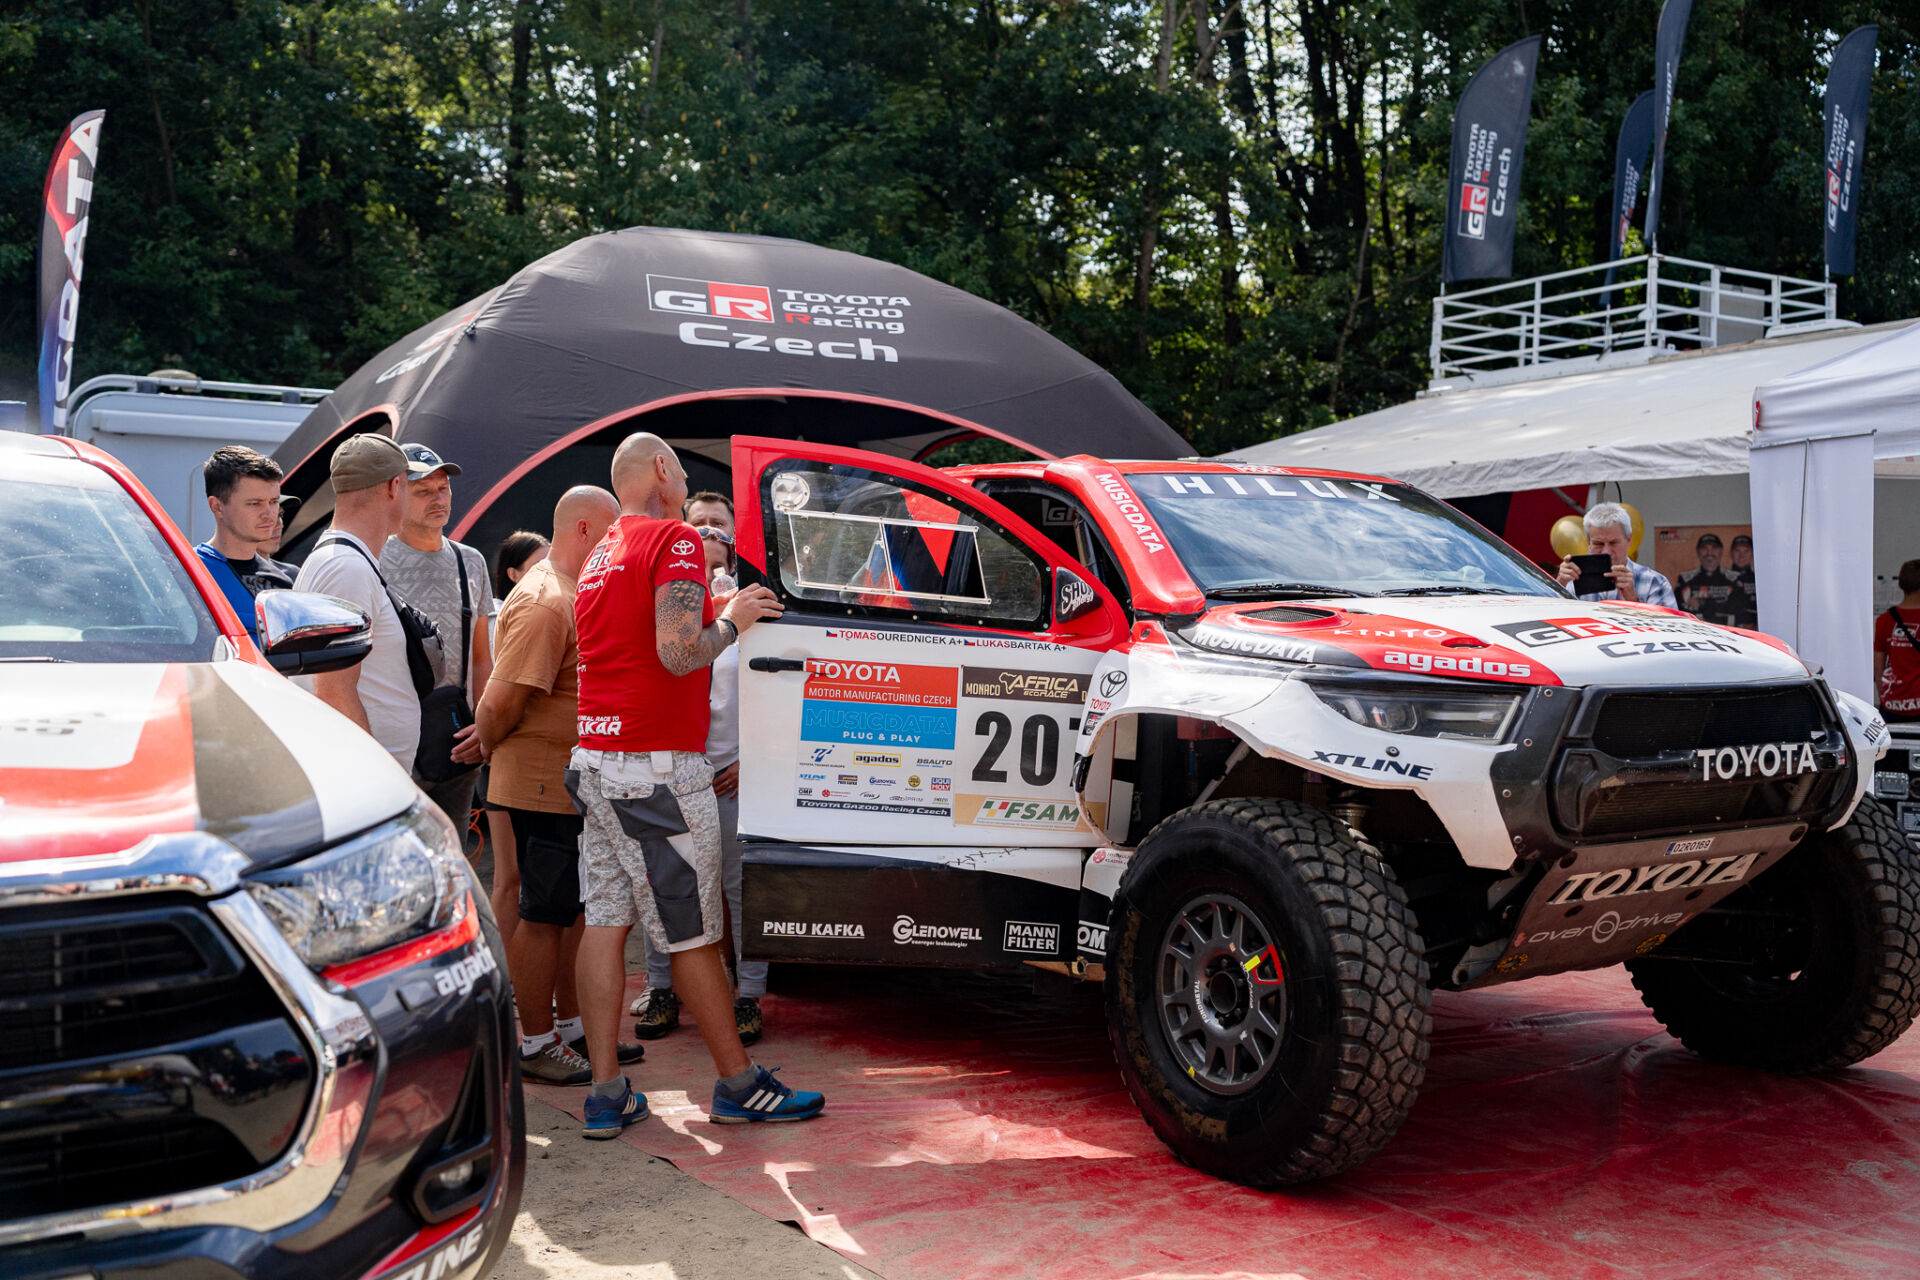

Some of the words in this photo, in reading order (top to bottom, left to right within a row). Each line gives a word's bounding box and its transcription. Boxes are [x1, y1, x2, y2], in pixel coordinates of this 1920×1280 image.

[1464, 123, 1480, 180] TOYOTA
[1473, 129, 1487, 182] GAZOO
[1481, 131, 1498, 183] Racing
[1492, 147, 1512, 217] Czech
[1840, 139, 1855, 212] Czech
[1468, 187, 1487, 236] GR
[654, 290, 769, 320] GR
[777, 289, 911, 307] TOYOTA
[782, 302, 904, 319] GAZOO
[785, 313, 905, 335] Racing
[678, 322, 899, 363] Czech
[1163, 476, 1400, 501] HILUX
[1095, 473, 1164, 554] MUSICDATA
[578, 579, 603, 593] Czech
[949, 637, 962, 645] A+
[1334, 628, 1447, 639] KINTO
[1515, 617, 1625, 647] GR
[1191, 631, 1317, 663] MUSICDATA
[1597, 640, 1743, 657] Czech
[811, 660, 901, 683] TOYOTA
[1384, 650, 1531, 678] agados
[808, 688, 841, 698] MOTOR
[843, 690, 921, 703] MANUFACTURING
[923, 695, 952, 705] CZECH
[965, 683, 1000, 697] MONACO
[1009, 674, 1079, 692] AFRICA
[577, 721, 622, 737] AKAR
[805, 708, 952, 735] MUSICDATA
[842, 731, 874, 740] PLUG
[878, 733, 885, 741] &
[891, 734, 921, 744] PLAY
[855, 754, 900, 764] agados
[1310, 750, 1434, 781] XTLINE
[1697, 742, 1818, 781] TOYOTA
[931, 777, 951, 785] LIQUI
[843, 803, 879, 811] GAZOO
[881, 806, 915, 814] Racing
[916, 808, 948, 816] Czech
[1005, 802, 1080, 821] FSAM
[1547, 852, 1762, 905] TOYOTA
[763, 921, 806, 935] PNEU
[812, 923, 865, 937] KAFKA
[893, 918, 982, 941] GLENOWELL
[1008, 924, 1056, 939] MANN
[1008, 937, 1055, 950] FILTER
